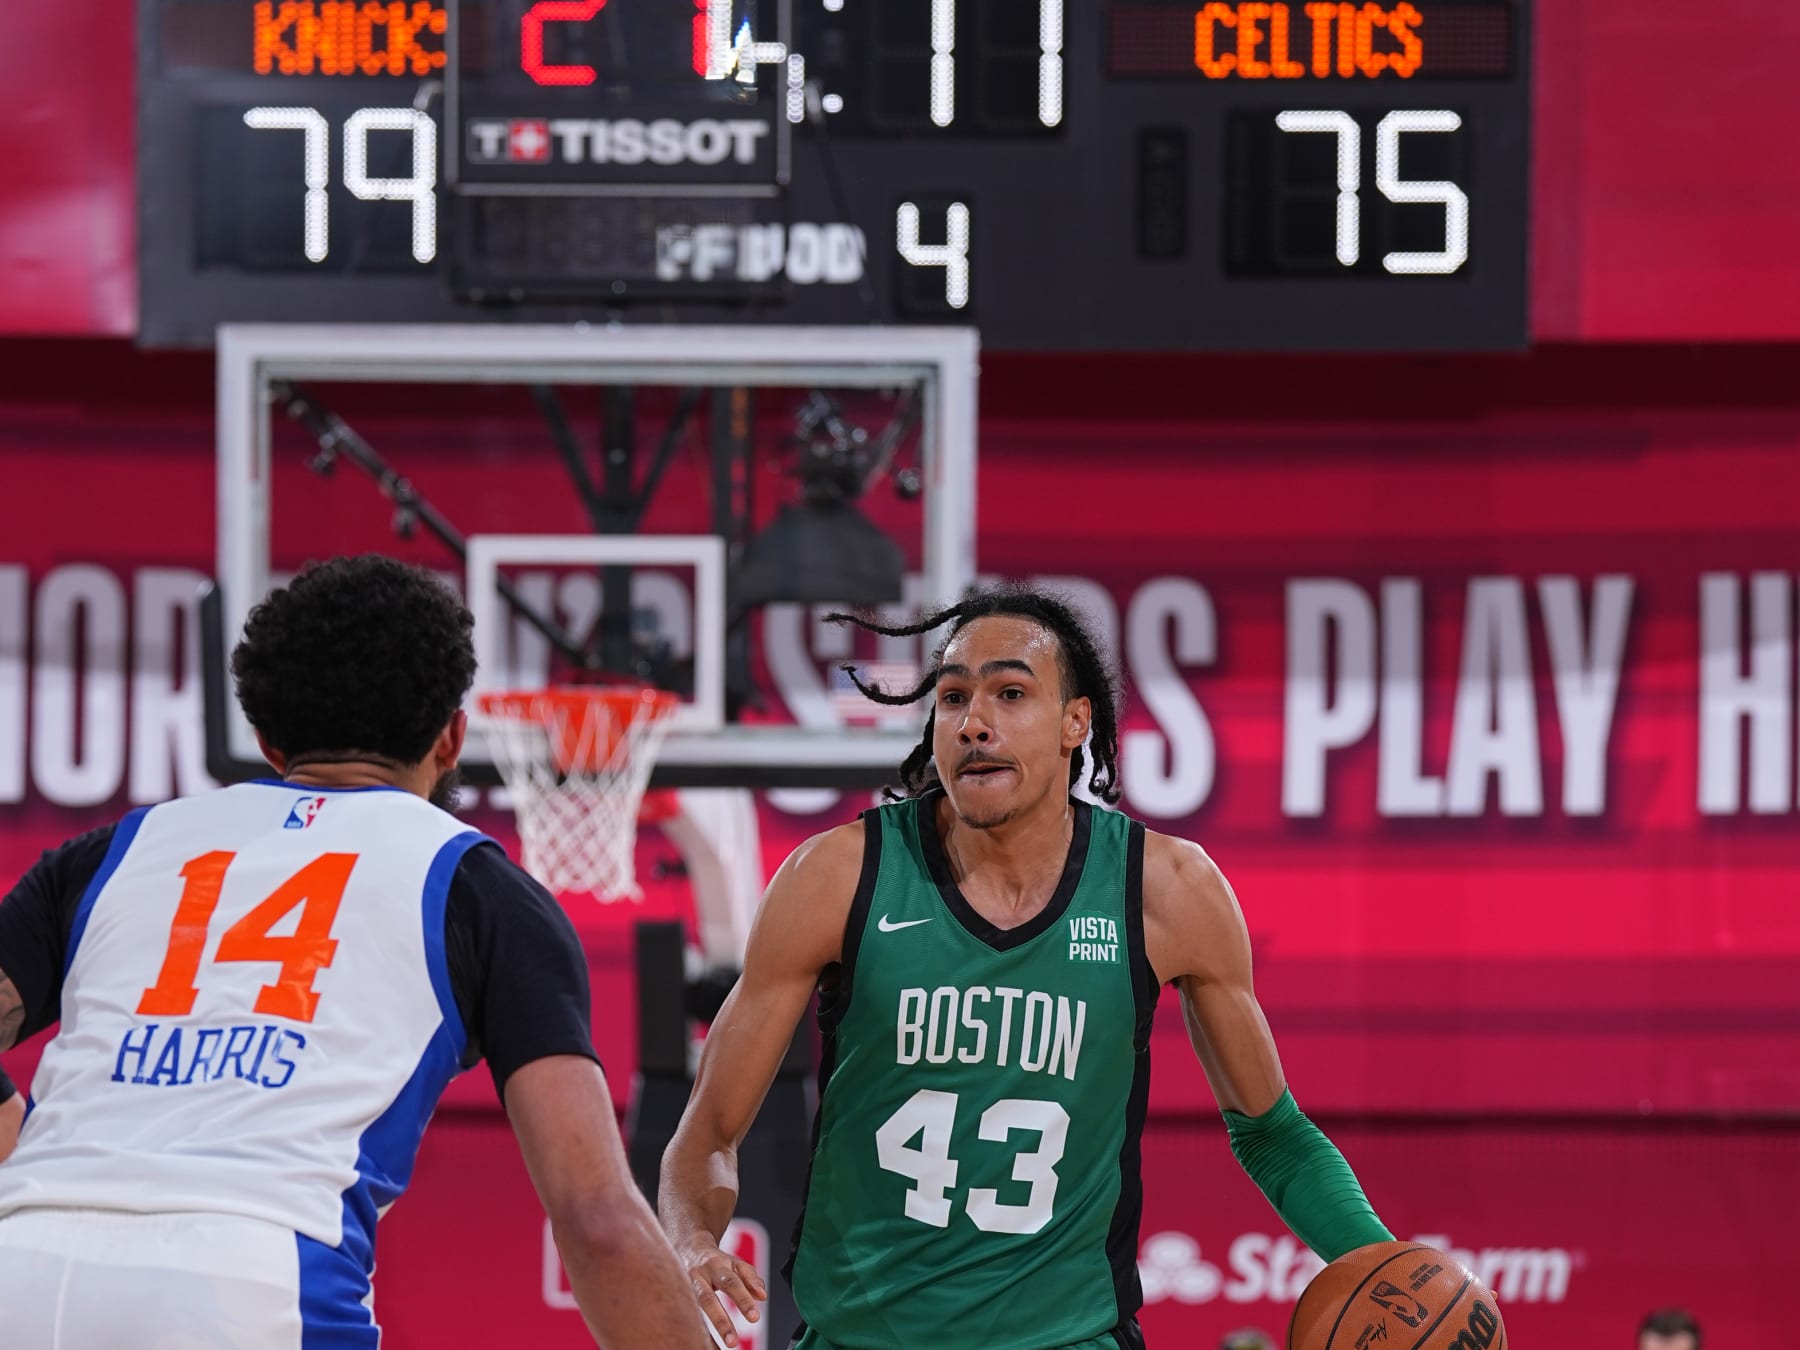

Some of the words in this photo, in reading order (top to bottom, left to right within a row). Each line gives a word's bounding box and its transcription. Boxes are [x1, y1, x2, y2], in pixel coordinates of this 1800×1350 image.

[1195, 2, 1423, 78] CELTICS
[243, 107, 436, 263] 79
[550, 121, 769, 164] TISSOT
[1275, 110, 1468, 274] 75
[898, 202, 969, 308] 4
[1282, 574, 1633, 817] PLAY
[135, 850, 360, 1023] 14
[1069, 916, 1118, 943] VISTA
[1069, 942, 1118, 961] PRINT
[111, 1024, 305, 1089] HARRIS
[896, 986, 1087, 1080] BOSTON
[875, 1089, 1071, 1234] 43
